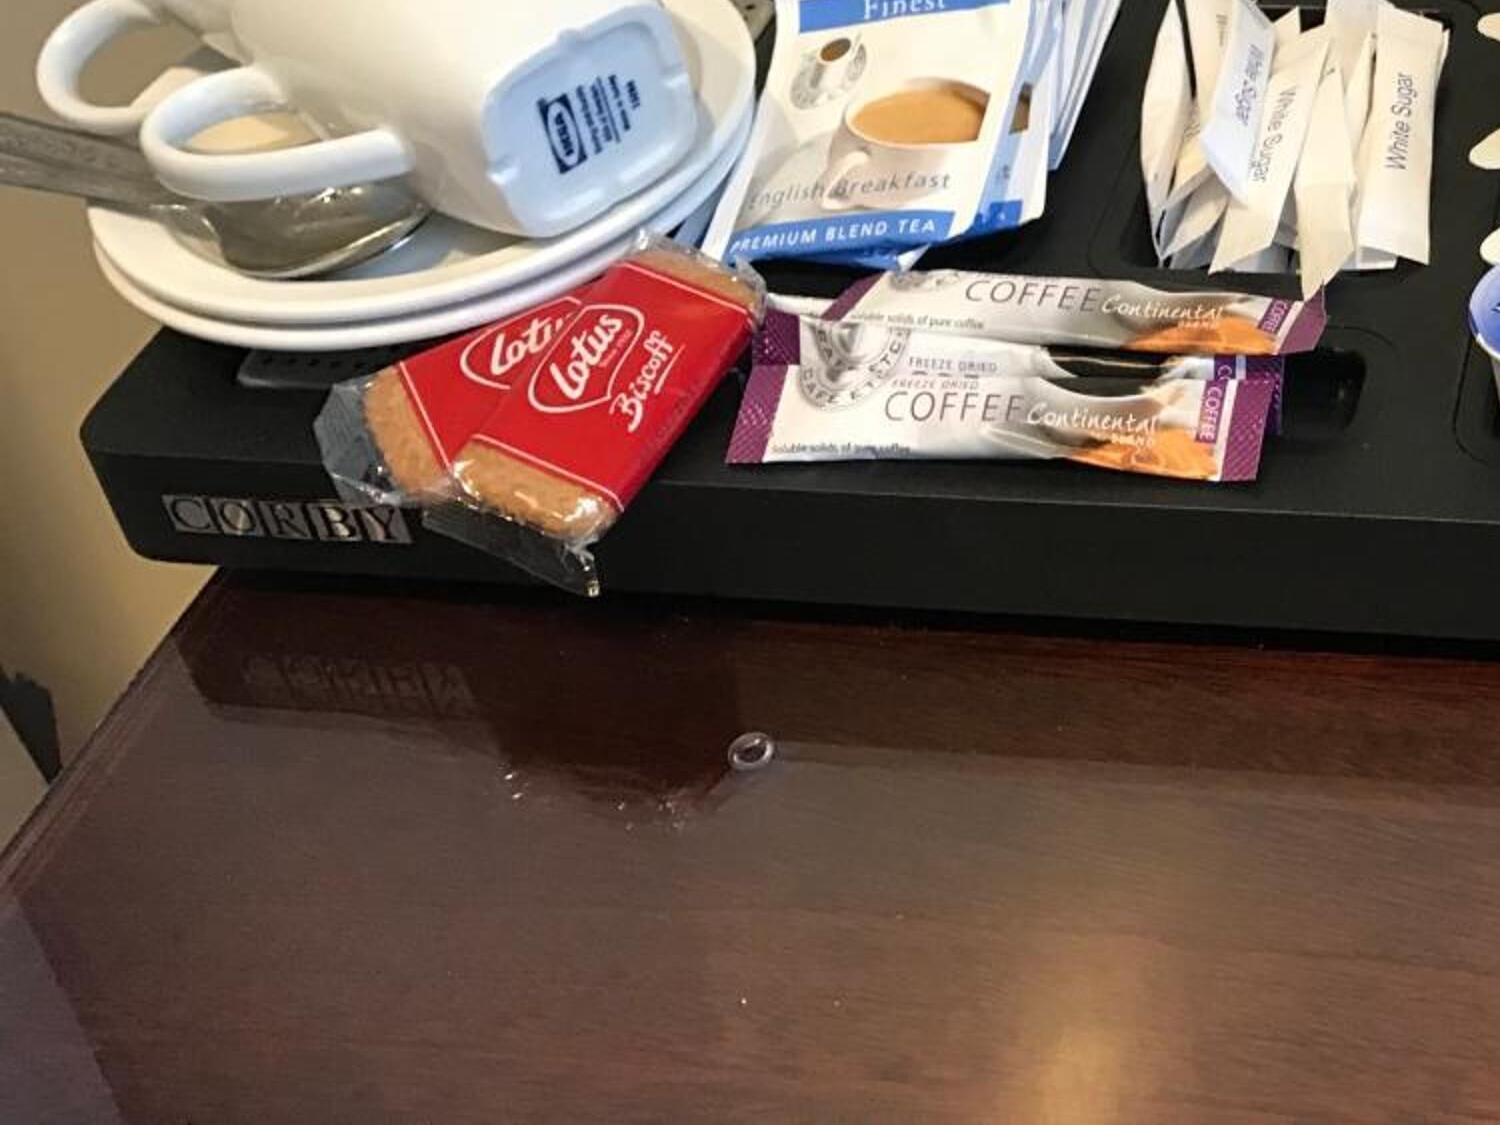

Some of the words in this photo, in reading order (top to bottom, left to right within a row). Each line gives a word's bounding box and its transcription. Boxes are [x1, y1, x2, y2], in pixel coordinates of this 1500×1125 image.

[1391, 71, 1420, 120] Sugar
[1385, 120, 1411, 171] White
[832, 173, 952, 199] Breakfast
[729, 229, 817, 255] PREMIUM
[825, 222, 888, 243] BLEND
[899, 218, 936, 233] TEA
[964, 279, 1101, 313] COFFEE
[1101, 293, 1224, 320] Continental
[489, 311, 577, 376] Lotu
[549, 313, 624, 401] Lotus
[957, 360, 998, 374] DRIED
[608, 329, 674, 434] Biscoff
[884, 390, 1024, 423] COFFEE
[1026, 402, 1159, 434] Continental
[1199, 386, 1224, 442] COFFEE
[163, 494, 408, 543] CORBY
